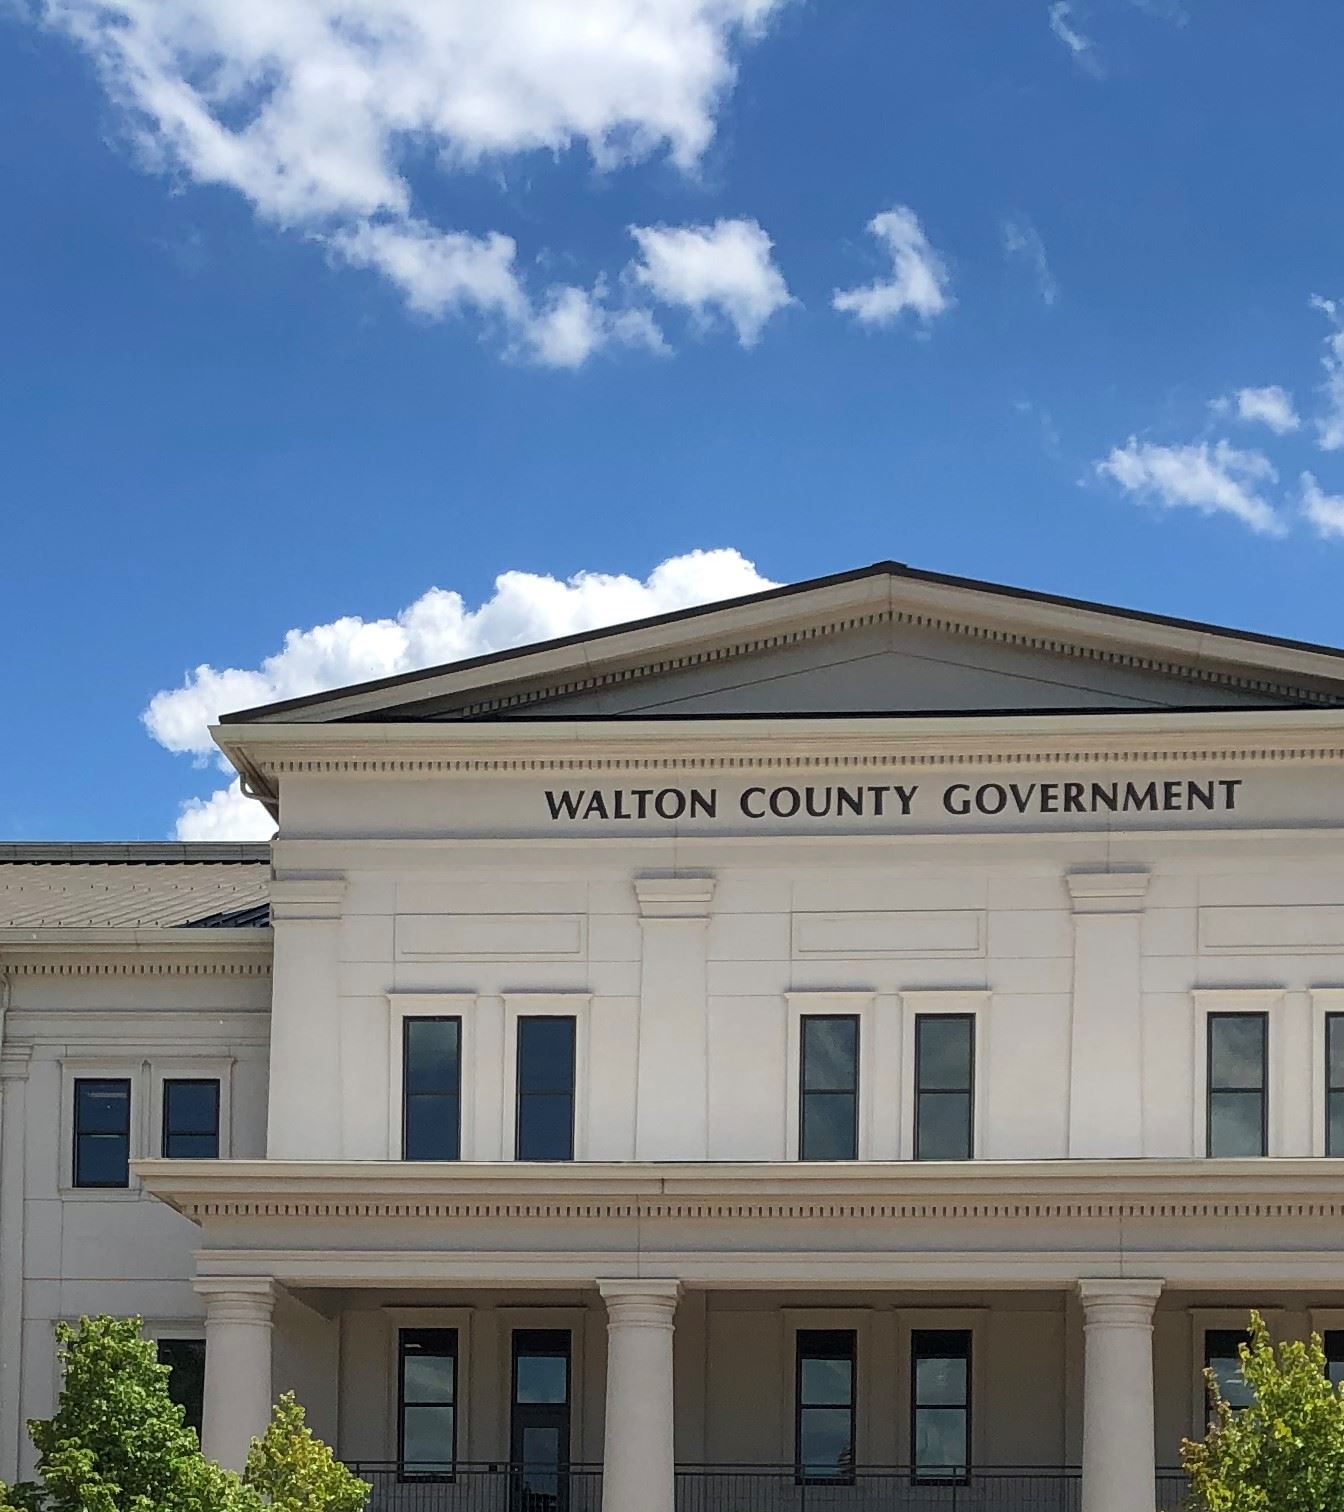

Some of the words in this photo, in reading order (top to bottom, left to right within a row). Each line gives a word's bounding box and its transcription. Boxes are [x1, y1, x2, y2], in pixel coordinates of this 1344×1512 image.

[545, 788, 718, 821] WALTON
[740, 785, 920, 820] COUNTY
[943, 780, 1244, 817] GOVERNMENT
